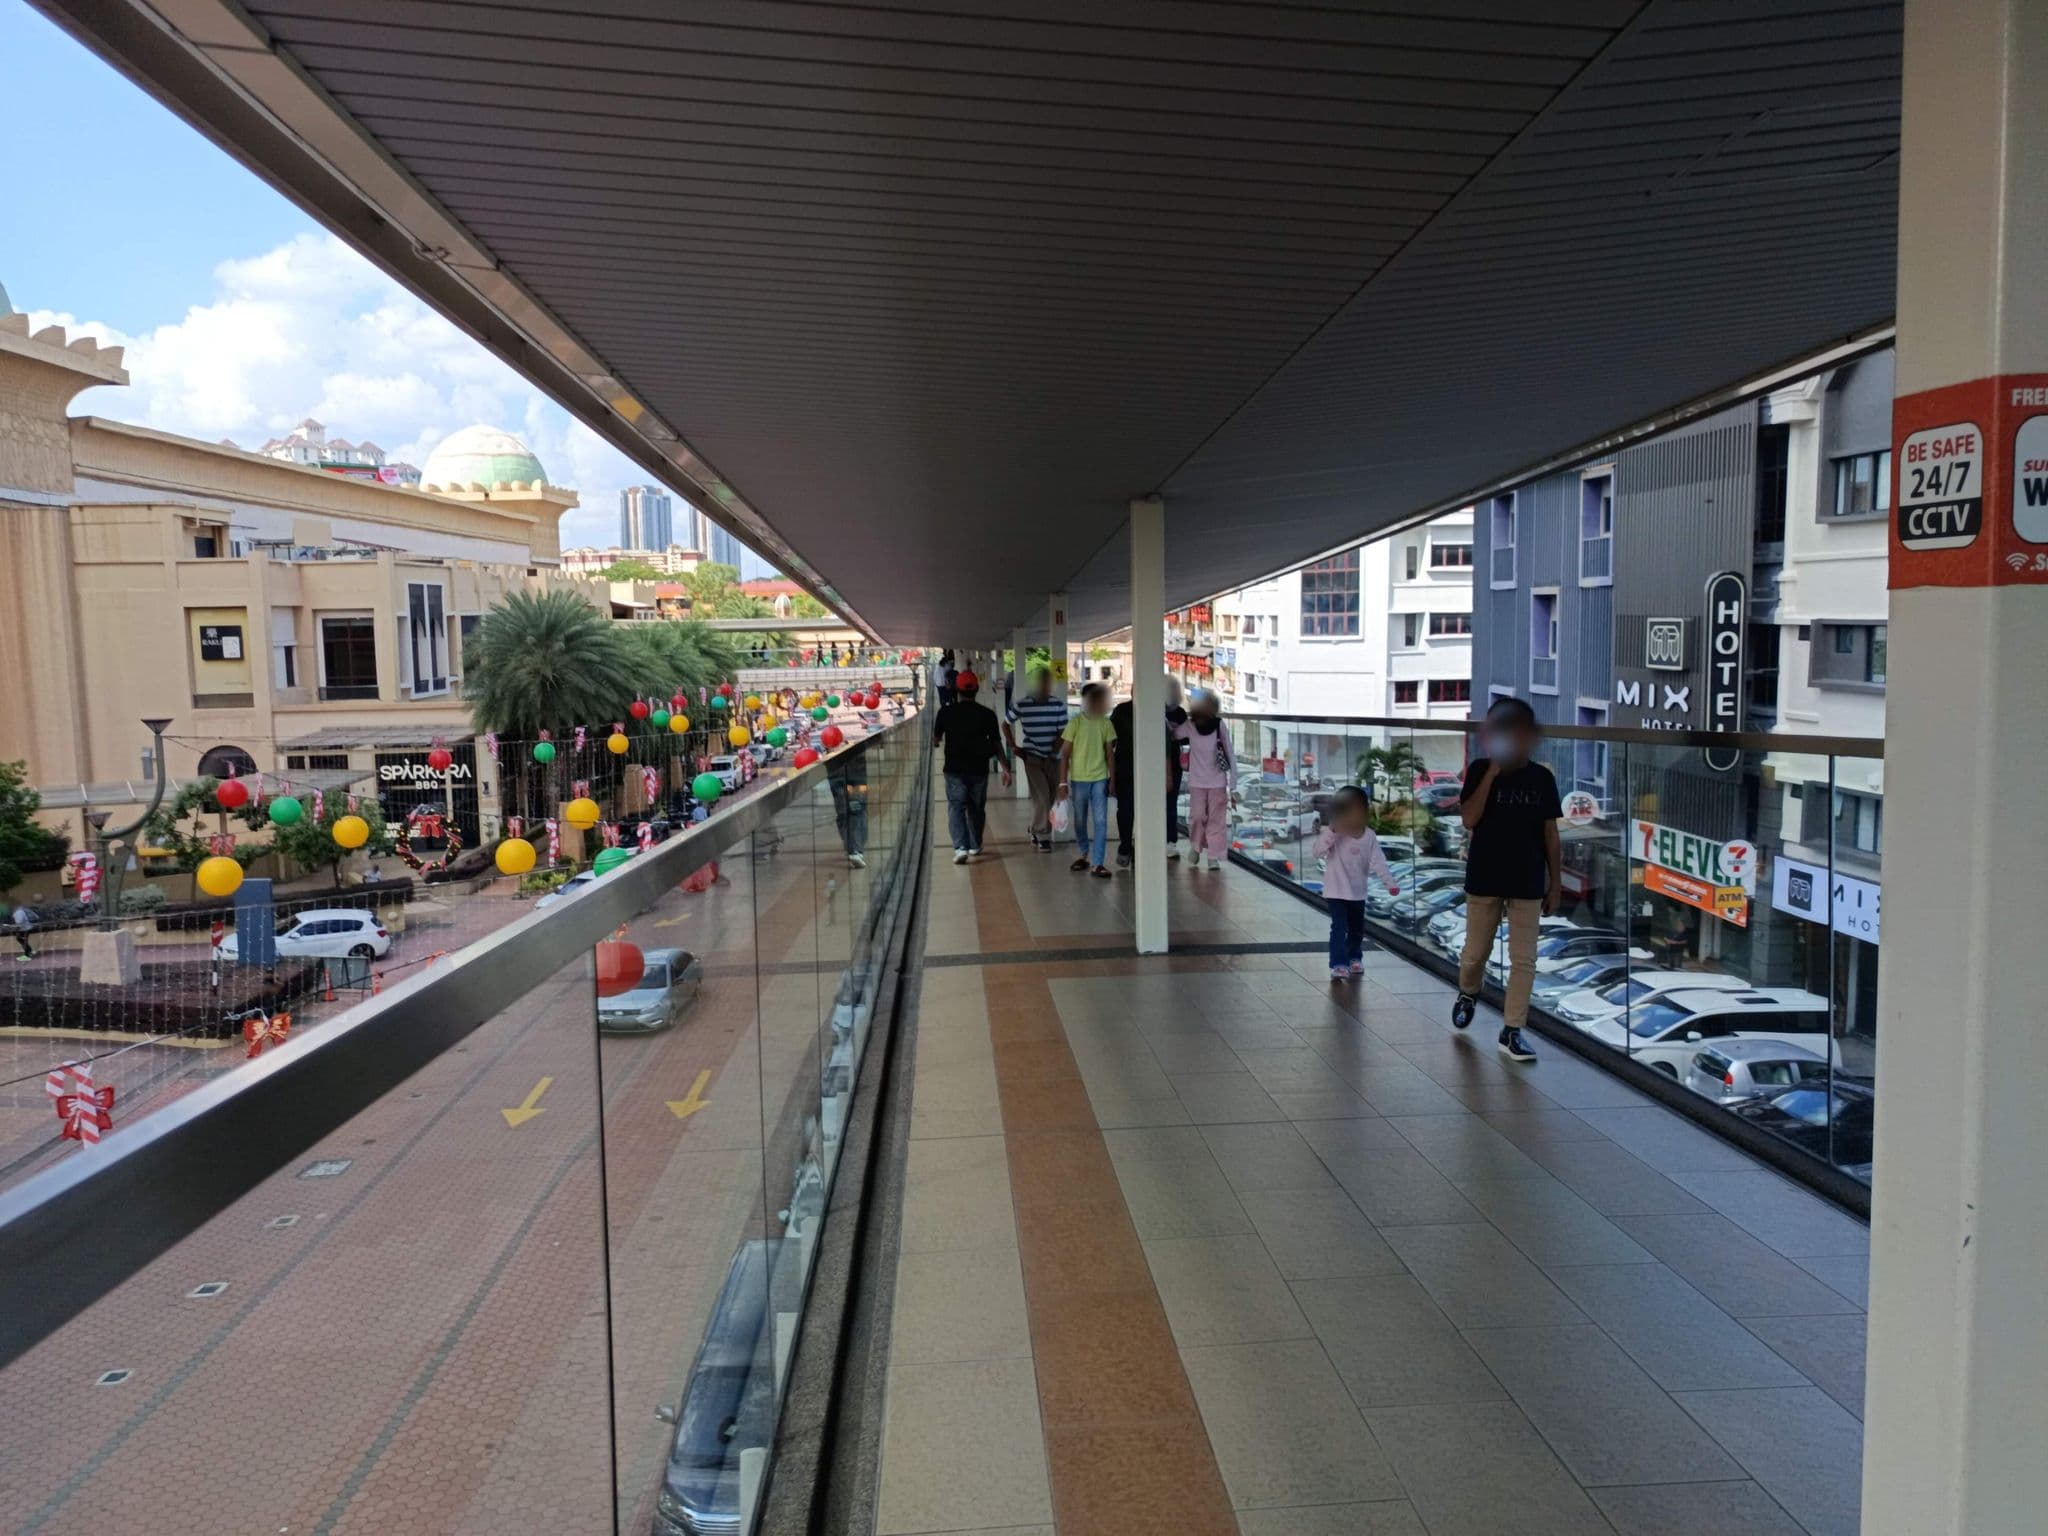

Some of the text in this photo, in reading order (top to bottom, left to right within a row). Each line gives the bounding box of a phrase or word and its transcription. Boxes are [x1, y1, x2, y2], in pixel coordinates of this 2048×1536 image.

[1907, 433, 1976, 463] BE SAFE
[1910, 461, 1971, 499] 24/7
[1908, 503, 1970, 536] CCTV
[1617, 679, 1690, 713] MIX
[415, 780, 439, 790] BBQ
[1638, 822, 1742, 886] 7-ELEVE
[1719, 893, 1742, 903] ATM
